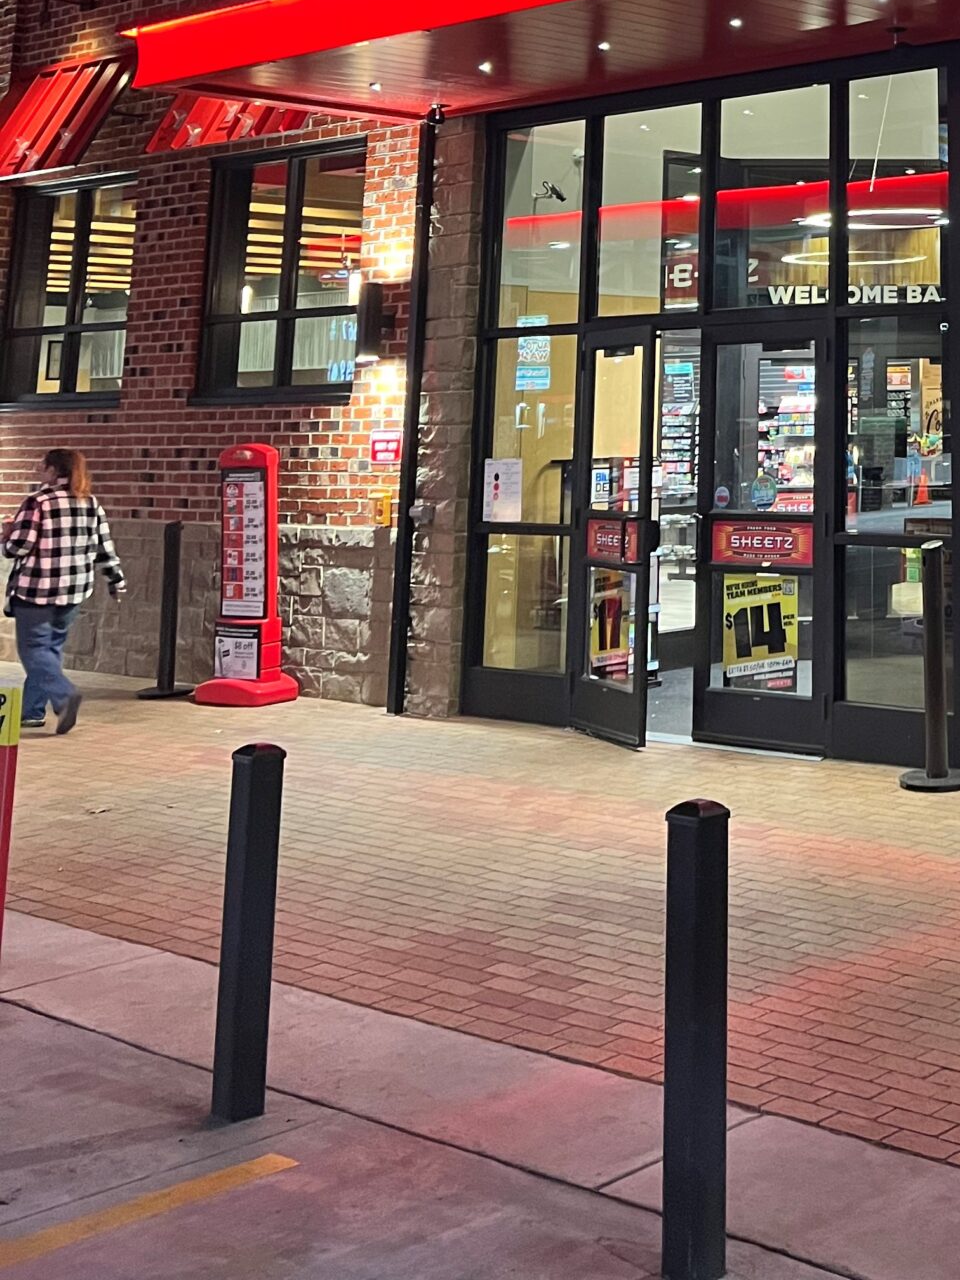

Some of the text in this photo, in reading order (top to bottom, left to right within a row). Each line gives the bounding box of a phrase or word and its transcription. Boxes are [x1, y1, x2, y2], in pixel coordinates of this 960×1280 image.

[596, 533, 629, 546] SHEEZ
[730, 535, 793, 549] SHEETZ
[726, 583, 782, 600] TEAM MEMBERS
[725, 602, 787, 659] $14
